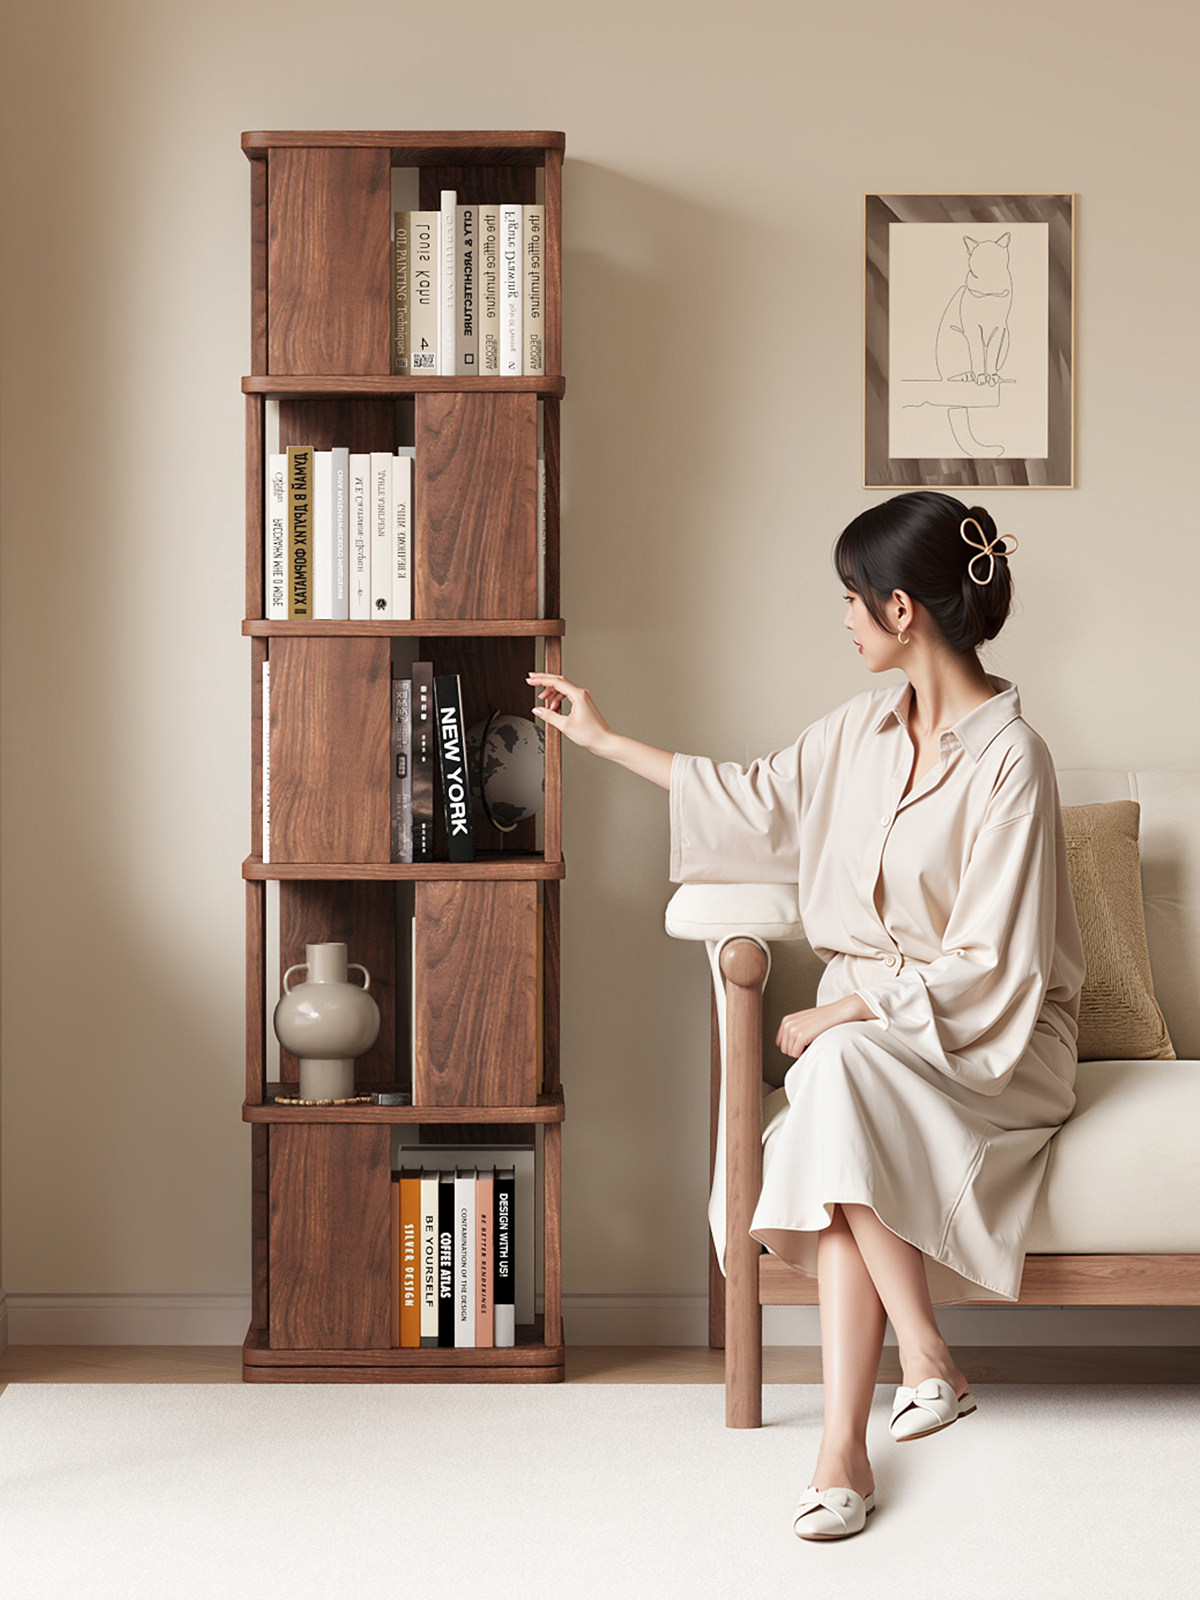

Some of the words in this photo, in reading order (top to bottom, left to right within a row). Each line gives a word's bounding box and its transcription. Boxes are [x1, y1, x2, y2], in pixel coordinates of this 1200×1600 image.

[396, 228, 406, 246] OIL
[396, 248, 407, 301] PAINTING
[394, 306, 407, 356] Techniques
[420, 338, 429, 350] 4
[440, 707, 461, 762] NEW
[447, 767, 468, 836] YORK
[425, 1216, 433, 1232] BE
[481, 1214, 486, 1224] BE
[499, 1193, 508, 1230] DESIGN
[404, 1224, 414, 1261] SILVER
[440, 1232, 452, 1266] COFFEE
[499, 1232, 508, 1258] WITH
[425, 1237, 433, 1307] YOURSELF
[440, 1270, 452, 1298] ATLAS
[461, 1269, 467, 1278] OF
[499, 1261, 508, 1278] US!
[404, 1267, 414, 1307] DESIGN
